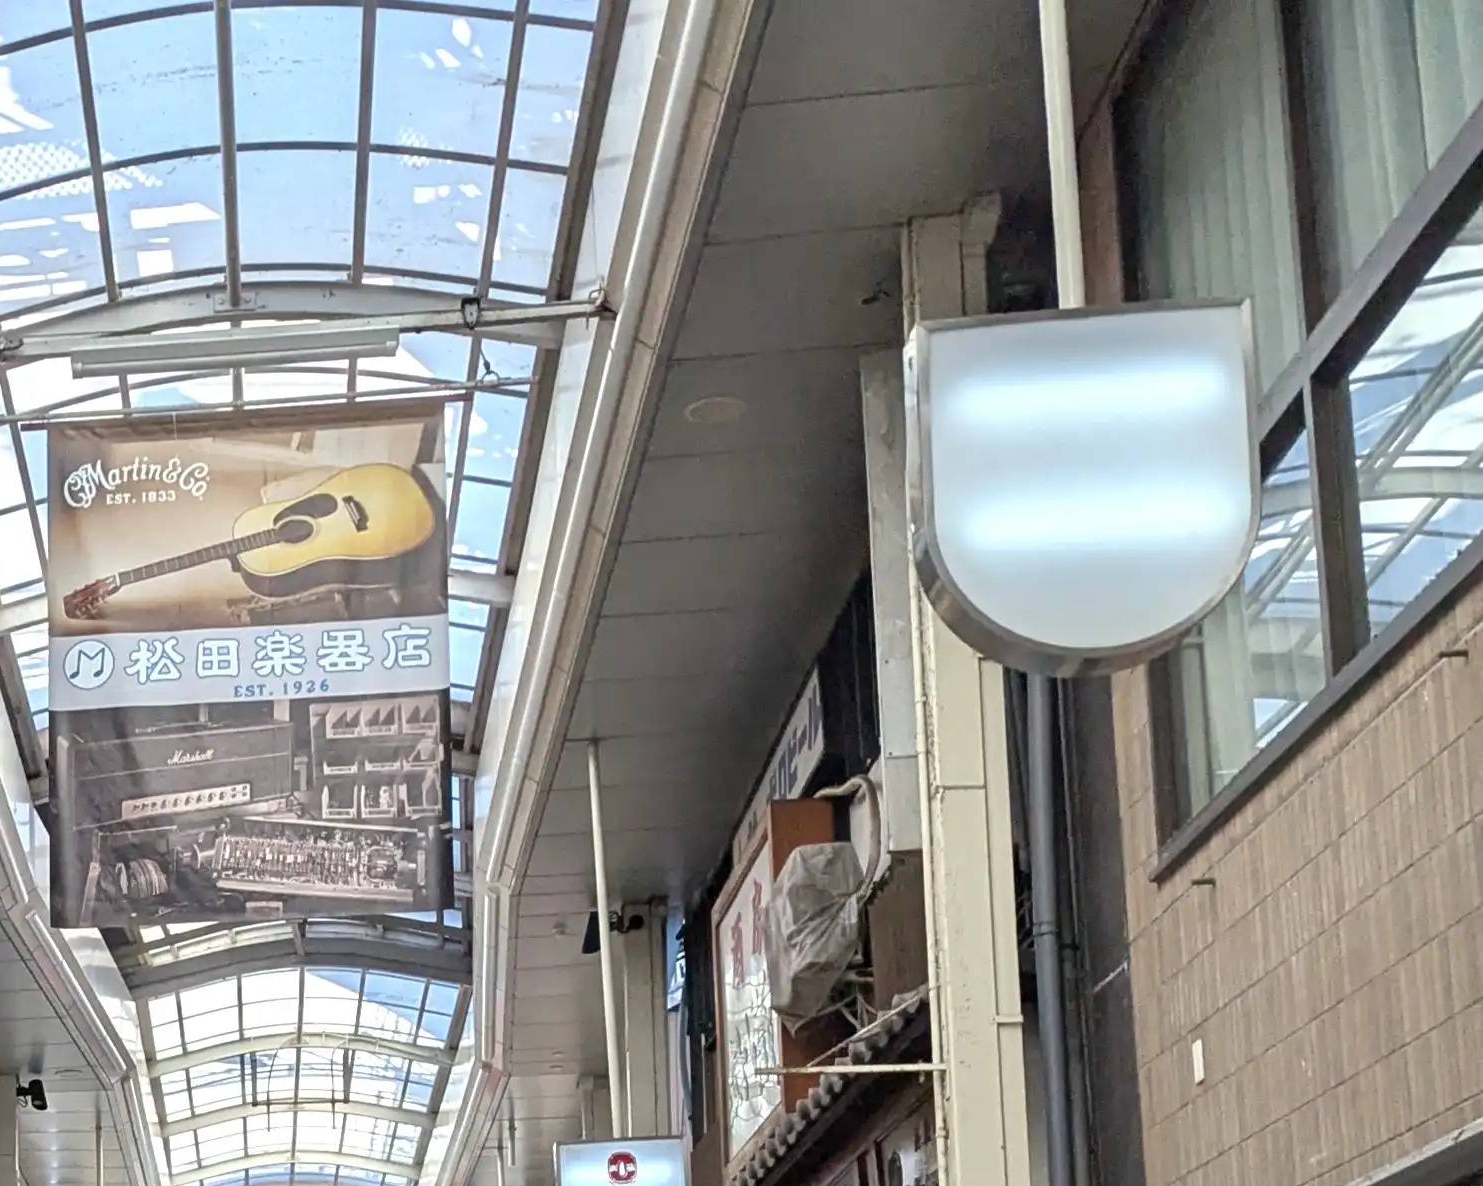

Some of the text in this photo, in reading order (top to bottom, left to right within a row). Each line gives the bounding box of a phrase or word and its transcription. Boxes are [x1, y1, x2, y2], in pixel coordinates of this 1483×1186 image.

[105, 489, 177, 506] EST. 1833
[124, 623, 433, 684] 松田楽器店
[233, 679, 331, 698] EST. 1926
[166, 748, 216, 766] Marshall
